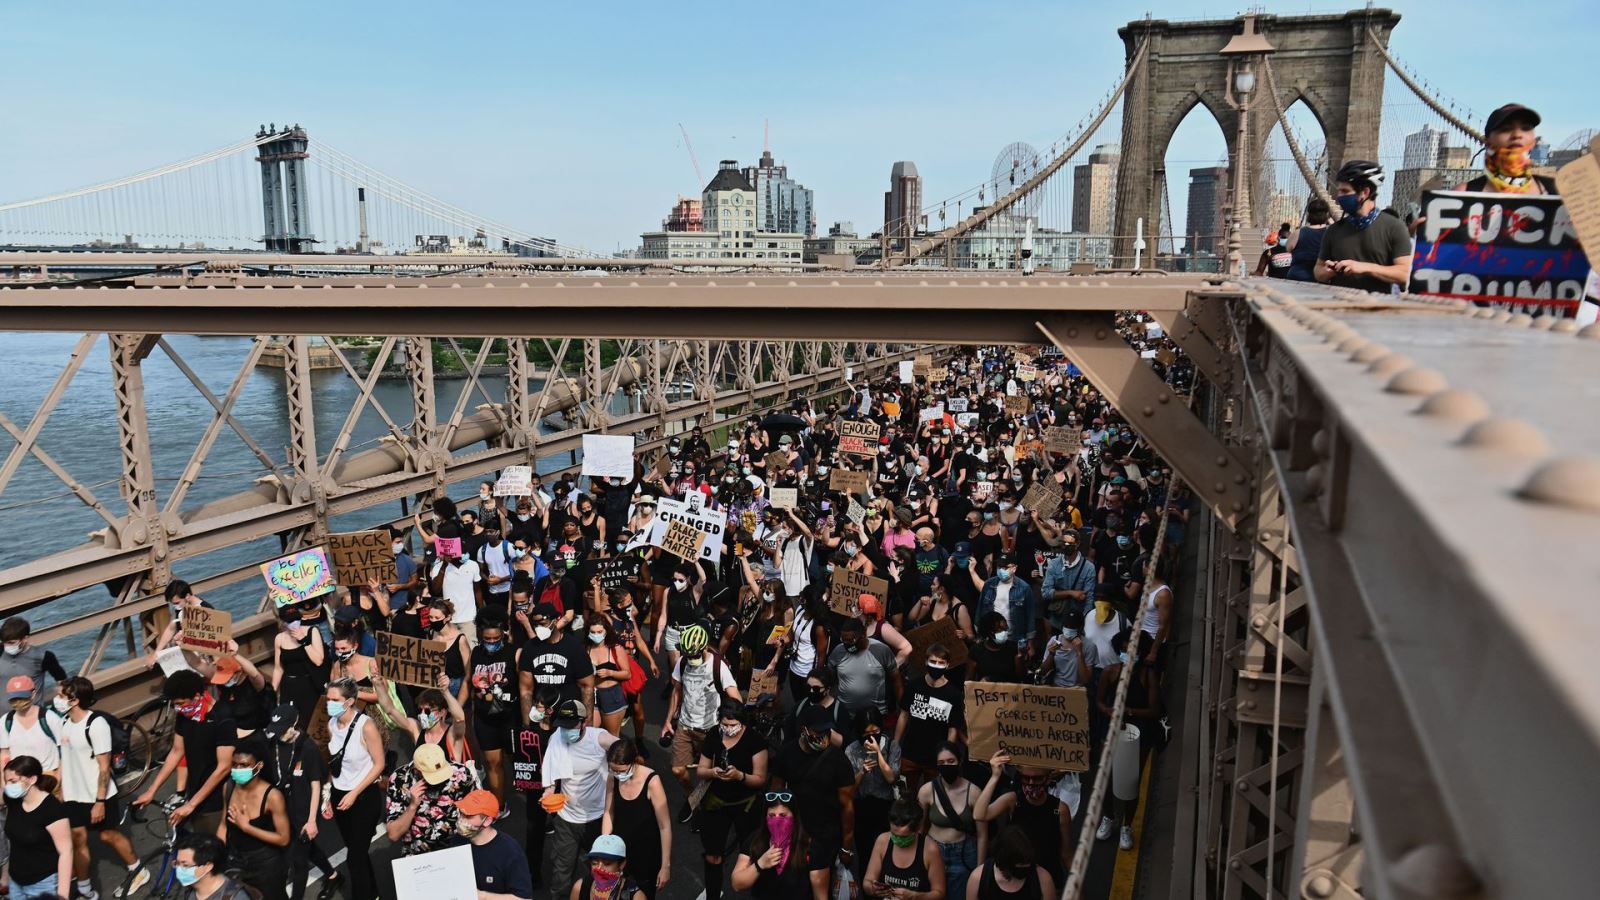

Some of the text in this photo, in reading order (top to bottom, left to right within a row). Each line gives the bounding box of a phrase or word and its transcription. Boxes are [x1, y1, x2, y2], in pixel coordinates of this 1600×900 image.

[842, 422, 879, 436] ENOUGH
[840, 436, 863, 446] BLACK
[843, 445, 868, 453] MATTER
[660, 511, 720, 535] CHANGED
[672, 521, 699, 540] BLACK
[329, 533, 385, 550] BLACK
[667, 529, 696, 548] LIVES
[333, 548, 395, 567] LIVES
[661, 538, 697, 560] MATTER
[279, 559, 295, 569] be
[597, 560, 623, 569] STOP
[337, 564, 398, 585] MATTER
[847, 571, 870, 587] END
[417, 639, 446, 667] Lives
[380, 656, 440, 687] MATTER
[974, 688, 1009, 706] REST
[1022, 688, 1066, 710] POWER
[995, 707, 1078, 726] GEORGE FLOYD
[997, 722, 1089, 748] AHMAUD ARBERY
[998, 741, 1086, 766] BREONNA TAYLOR
[514, 762, 537, 772] RESIST
[515, 771, 532, 780] AND
